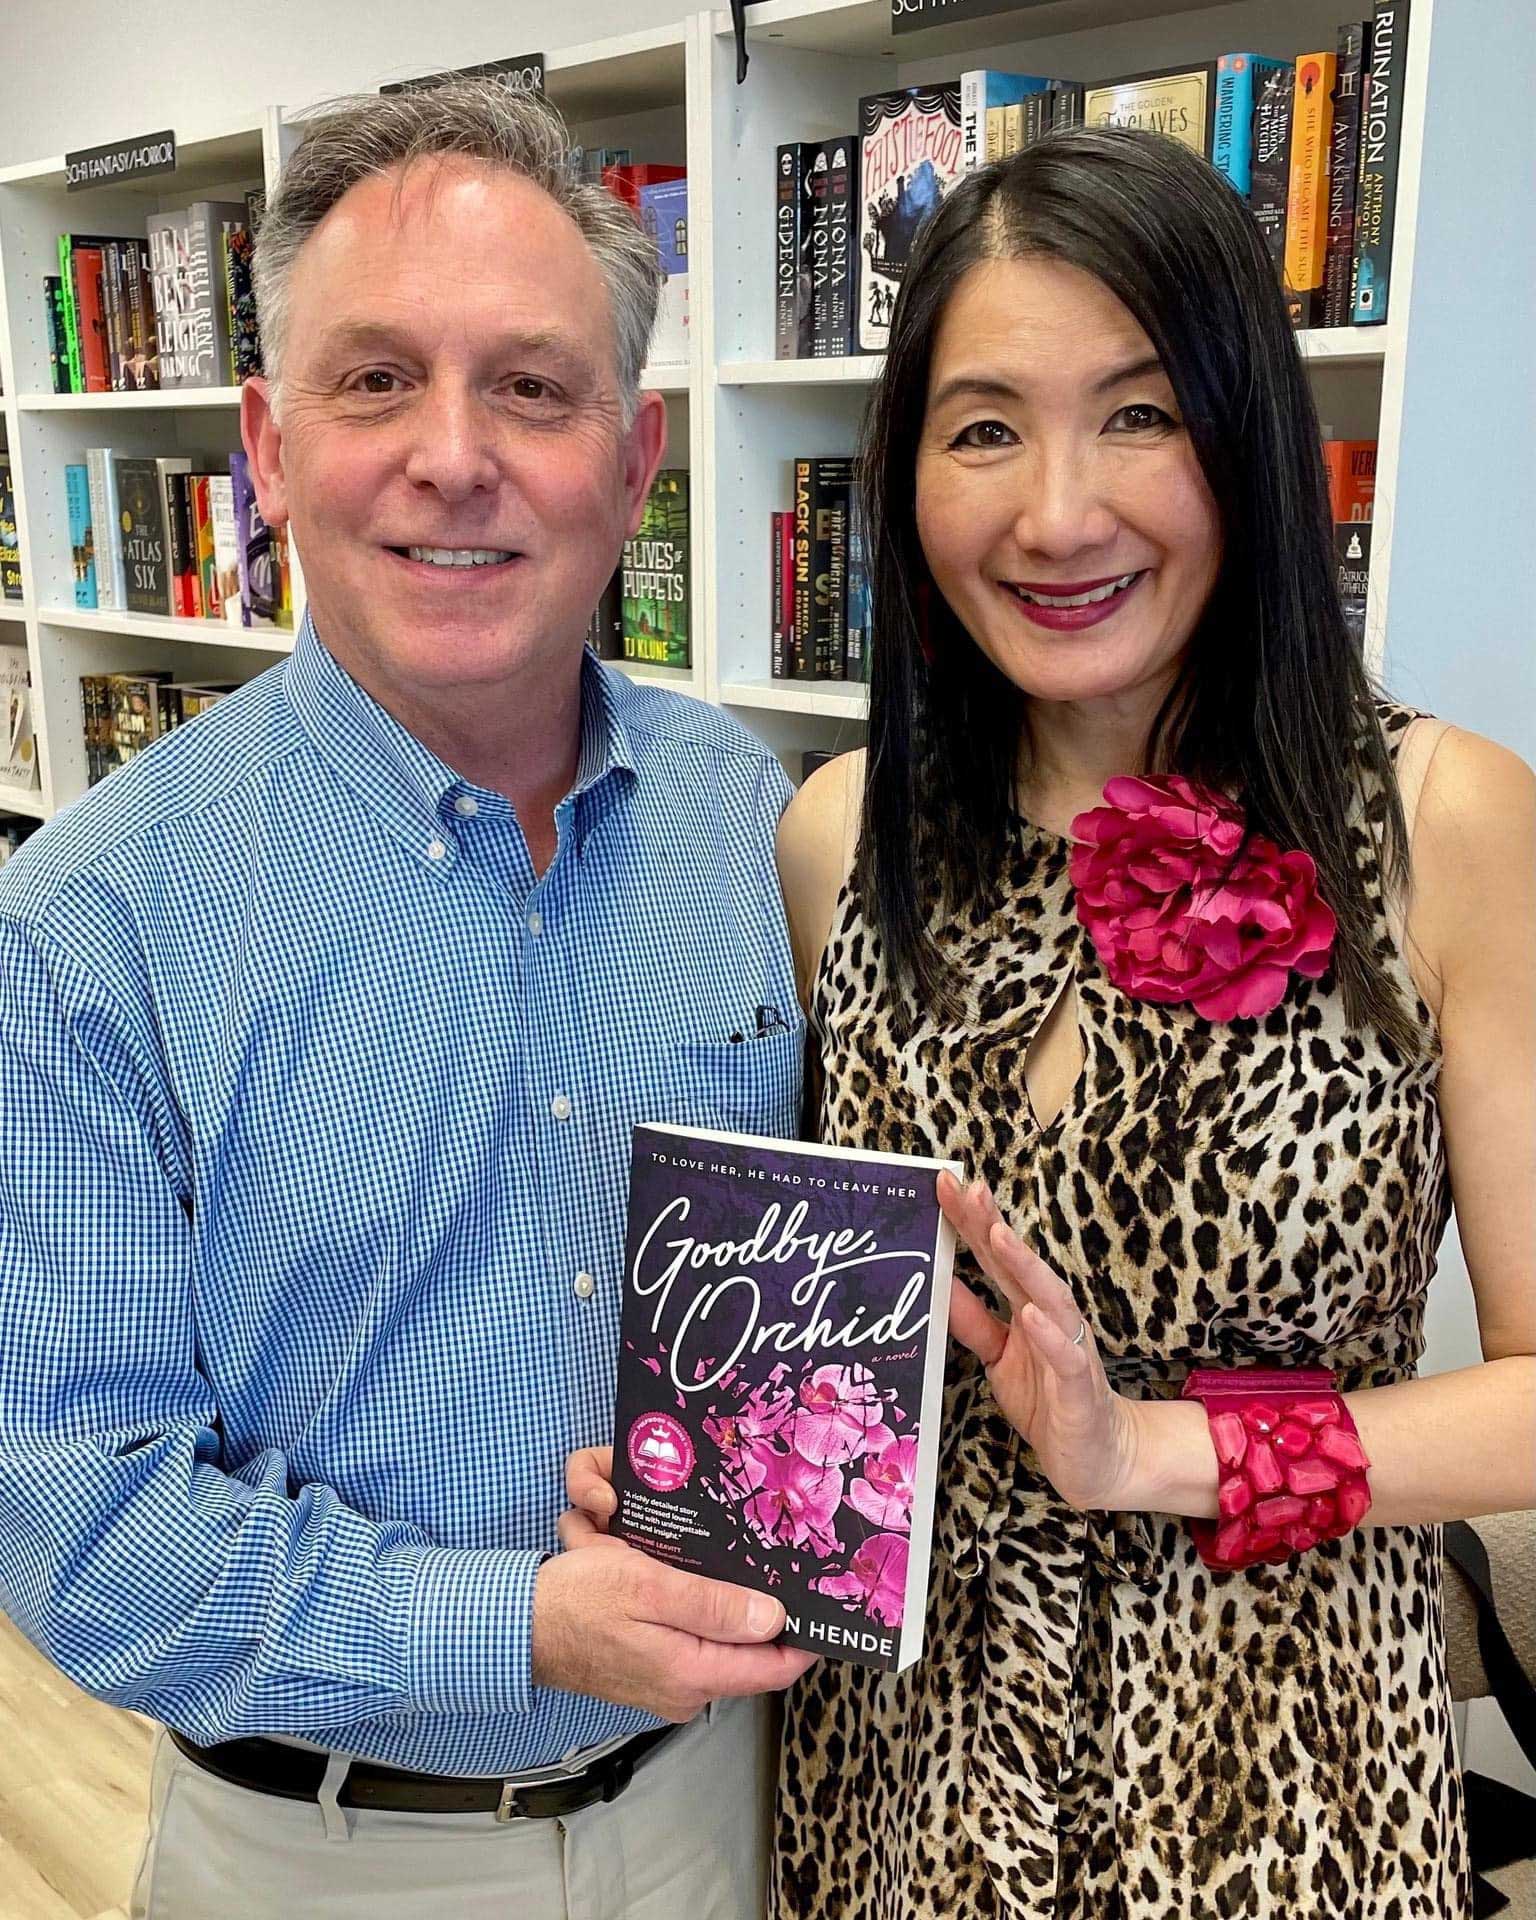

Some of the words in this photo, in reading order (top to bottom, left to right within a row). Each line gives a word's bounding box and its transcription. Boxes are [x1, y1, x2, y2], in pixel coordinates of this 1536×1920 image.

[1120, 103, 1136, 112] THE
[1137, 96, 1174, 110] GOLDEN
[1366, 10, 1394, 164] RUINATION
[1217, 77, 1235, 150] WANDERING
[1278, 113, 1288, 143] WHEN
[1306, 107, 1316, 132] SHE
[965, 111, 977, 154] THE
[1258, 104, 1273, 162] HATCHED
[1268, 117, 1279, 155] MOON
[89, 141, 174, 179] FANTASY/HORROR
[862, 113, 963, 197] THISTLEFOOT
[1304, 135, 1314, 170] WHO
[1329, 121, 1351, 229] AWAKENING
[1300, 173, 1313, 222] BECAME
[1369, 173, 1385, 247] ANTHONY
[813, 203, 829, 289] NONA
[831, 200, 848, 287] NONA
[1298, 227, 1310, 251] THE
[1296, 256, 1307, 283] SUN
[779, 299, 787, 335] NINTH
[813, 294, 821, 331] NINTH
[831, 292, 839, 330] NINTH
[157, 318, 200, 353] LEIGH
[795, 463, 810, 535] BLACK
[127, 539, 162, 563] ATLAS
[632, 541, 674, 570] LIVES
[674, 551, 683, 562] OF
[795, 540, 810, 583] SUN
[134, 564, 157, 590] SIX
[622, 570, 684, 602] PUPPETS
[623, 637, 635, 657] TJ
[637, 639, 668, 661] KLUNE
[773, 632, 783, 655] Anne
[773, 656, 783, 675] Rice
[651, 1152, 667, 1164] TO
[671, 1157, 705, 1171] LOVE
[710, 1164, 742, 1178] HER,
[748, 1169, 766, 1180] HE
[772, 1173, 801, 1185] HAD
[808, 1177, 827, 1188] TO
[833, 1180, 880, 1195] LEAVE
[887, 1186, 917, 1199] HER
[632, 1196, 931, 1334] Goodbye,
[670, 1271, 931, 1392] Orchid
[870, 1355, 882, 1363] a
[885, 1345, 919, 1363] novel
[622, 1508, 631, 1516] all
[631, 1510, 644, 1520] told
[644, 1515, 661, 1525] with
[661, 1520, 711, 1538] unforgettable
[623, 1499, 631, 1507] of
[630, 1502, 671, 1519] star-crossed
[631, 1493, 650, 1505] richly
[650, 1499, 679, 1512] detailed
[679, 1506, 698, 1518] story
[622, 1517, 639, 1529] heart
[639, 1523, 653, 1533] and
[655, 1541, 682, 1553] LEAVITT
[785, 1617, 801, 1635] N
[809, 1621, 894, 1657] HENDE
